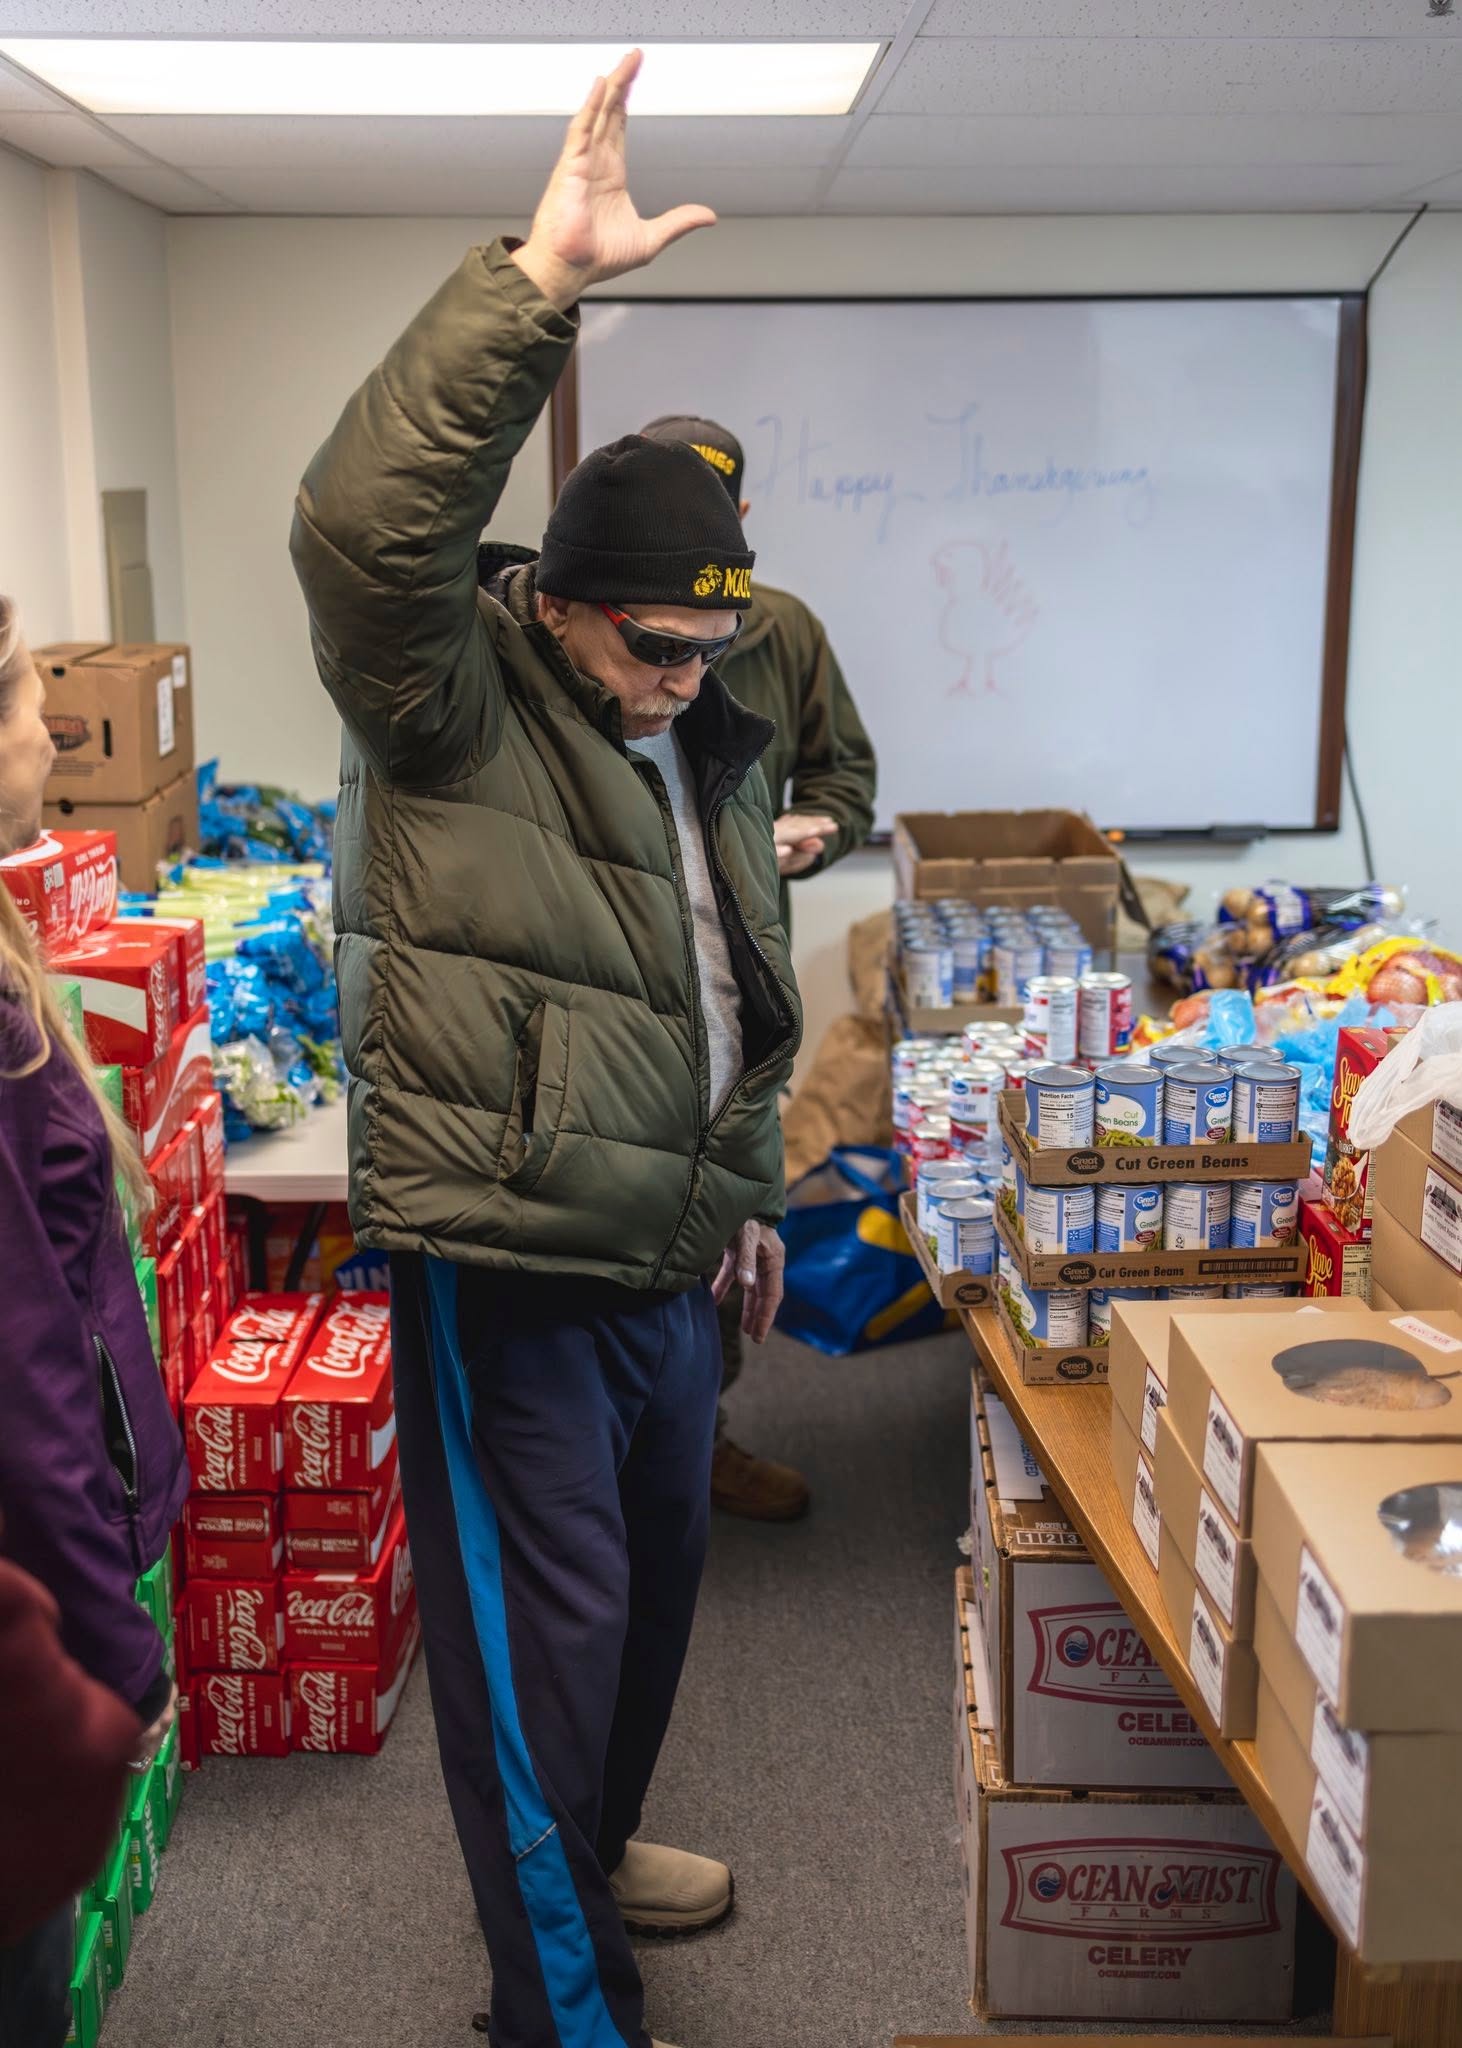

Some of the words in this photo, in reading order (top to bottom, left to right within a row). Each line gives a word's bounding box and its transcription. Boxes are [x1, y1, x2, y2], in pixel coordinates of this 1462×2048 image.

[754, 415, 897, 545] Happy
[1208, 1091, 1227, 1099] Great
[1124, 1111, 1139, 1119] Cut
[1113, 1118, 1139, 1127] Beans
[1072, 1156, 1098, 1165] Great
[1115, 1157, 1141, 1170] Cut
[1147, 1156, 1195, 1170] Green
[1202, 1155, 1249, 1168] Beans
[1137, 1195, 1156, 1203] Great
[1306, 1235, 1334, 1285] Stove
[1063, 1267, 1090, 1275] Great
[1099, 1267, 1115, 1278] Cut
[1120, 1267, 1149, 1278] Green
[1154, 1266, 1184, 1277] Beans
[1061, 1361, 1087, 1369] Great
[1096, 1363, 1108, 1373] Cu
[238, 1412, 246, 1441] TASTE
[335, 1409, 343, 1437] TASTE
[238, 1444, 247, 1485] ORIGINAL
[335, 1440, 343, 1481] ORIGINAL
[1034, 1522, 1062, 1530] PACKER
[1025, 1533, 1033, 1543] 1
[1046, 1533, 1056, 1543] 2
[1068, 1533, 1078, 1544] 3
[1056, 1625, 1160, 1668] OCEA
[1118, 1712, 1197, 1733] CELE
[1028, 1862, 1152, 1903] OCEAN
[1149, 1864, 1259, 1909] MIST
[1080, 1907, 1211, 1920] FARMS
[1088, 1946, 1192, 1967] CELERY
